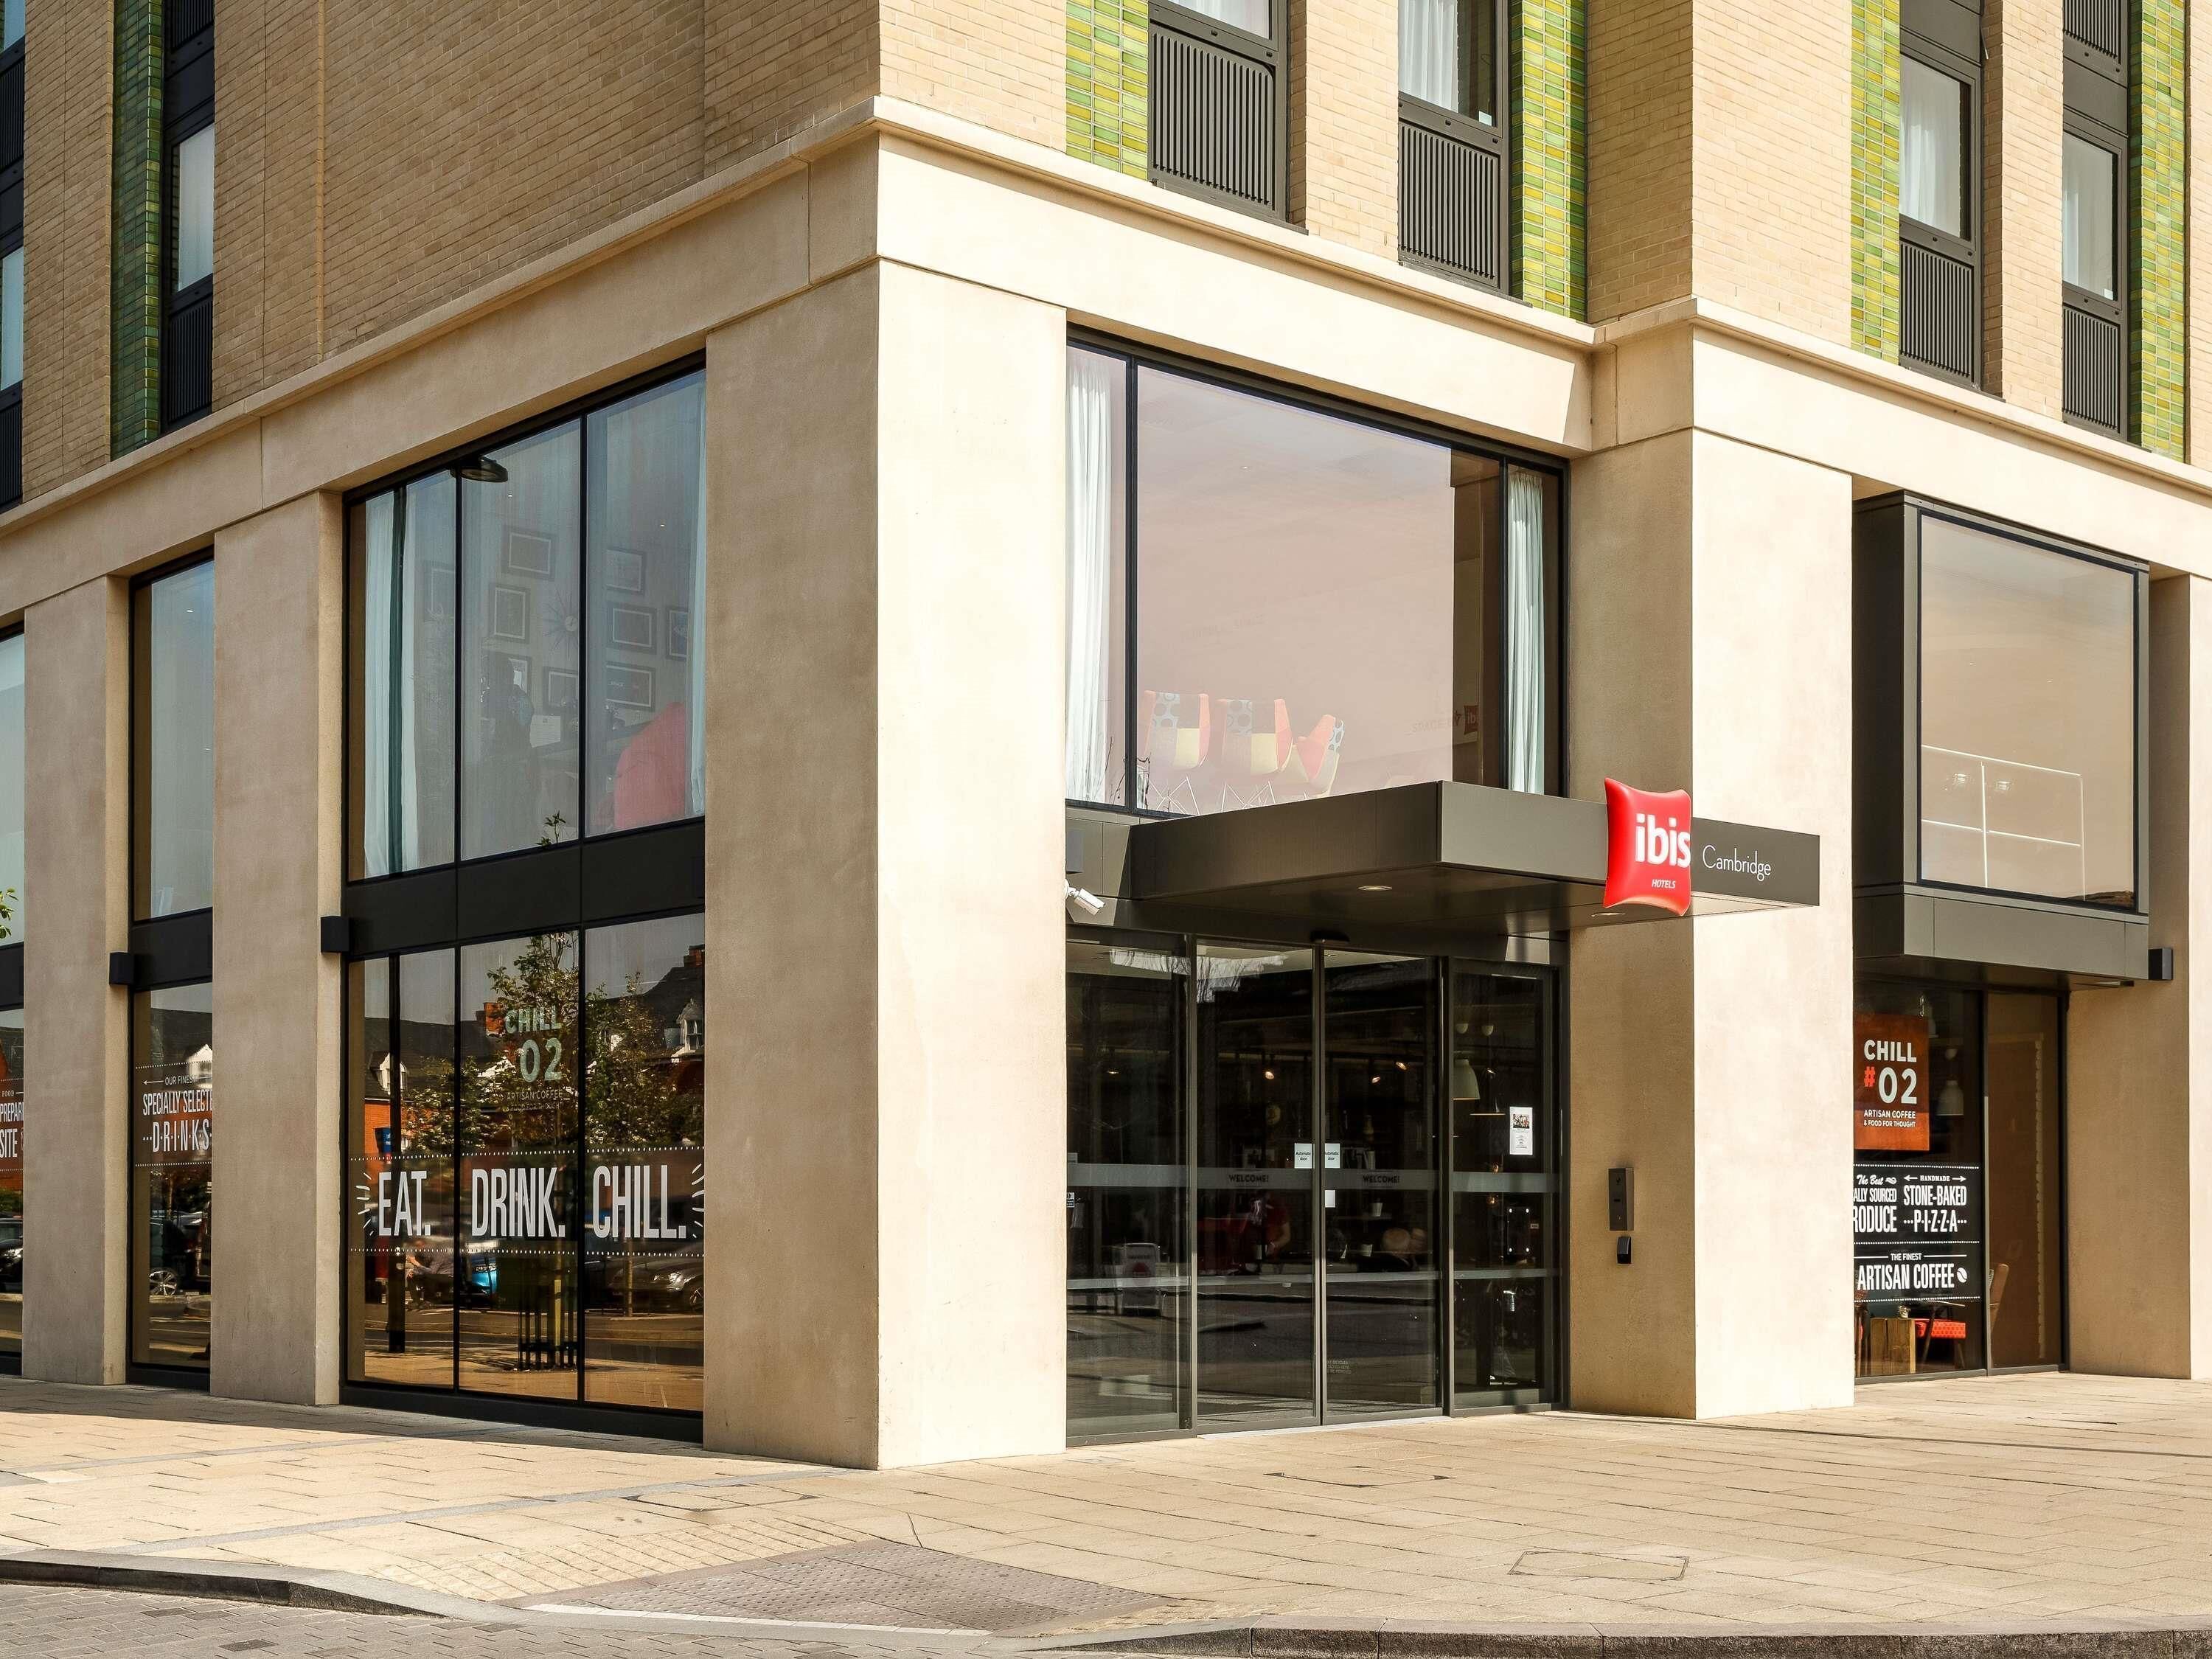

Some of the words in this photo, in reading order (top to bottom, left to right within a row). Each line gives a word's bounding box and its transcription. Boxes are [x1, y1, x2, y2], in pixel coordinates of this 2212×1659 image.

[1635, 813, 1691, 869] ibis
[1703, 844, 1771, 882] Cambridge
[1652, 878, 1676, 889] HOTELS
[505, 1004, 563, 1034] CHILL
[1863, 1039, 1917, 1062] CHILL
[165, 1077, 176, 1085] OUR
[178, 1075, 197, 1084] FINEST
[1863, 1066, 1918, 1105] #02
[143, 1091, 181, 1116] SPECIALLY
[1863, 1109, 1891, 1118] ARTISAN
[1891, 1110, 1916, 1119] COFFEE
[1228, 1175, 1269, 1183] WELCOME!
[1363, 1175, 1400, 1183] WELCOME!
[1857, 1174, 1868, 1185] The
[1870, 1174, 1883, 1185] Best
[378, 1171, 431, 1236] EAT.
[472, 1167, 566, 1237] DRINK.
[593, 1164, 686, 1238] CHILL.
[1854, 1188, 1868, 1202] ALLY
[1869, 1188, 1897, 1202] SOURCED
[1903, 1184, 1967, 1206] STONE-BAKED
[1902, 1253, 1922, 1261] FINEST
[1857, 1264, 1910, 1290] ARTISAN
[1913, 1263, 1955, 1290] COFFEE
